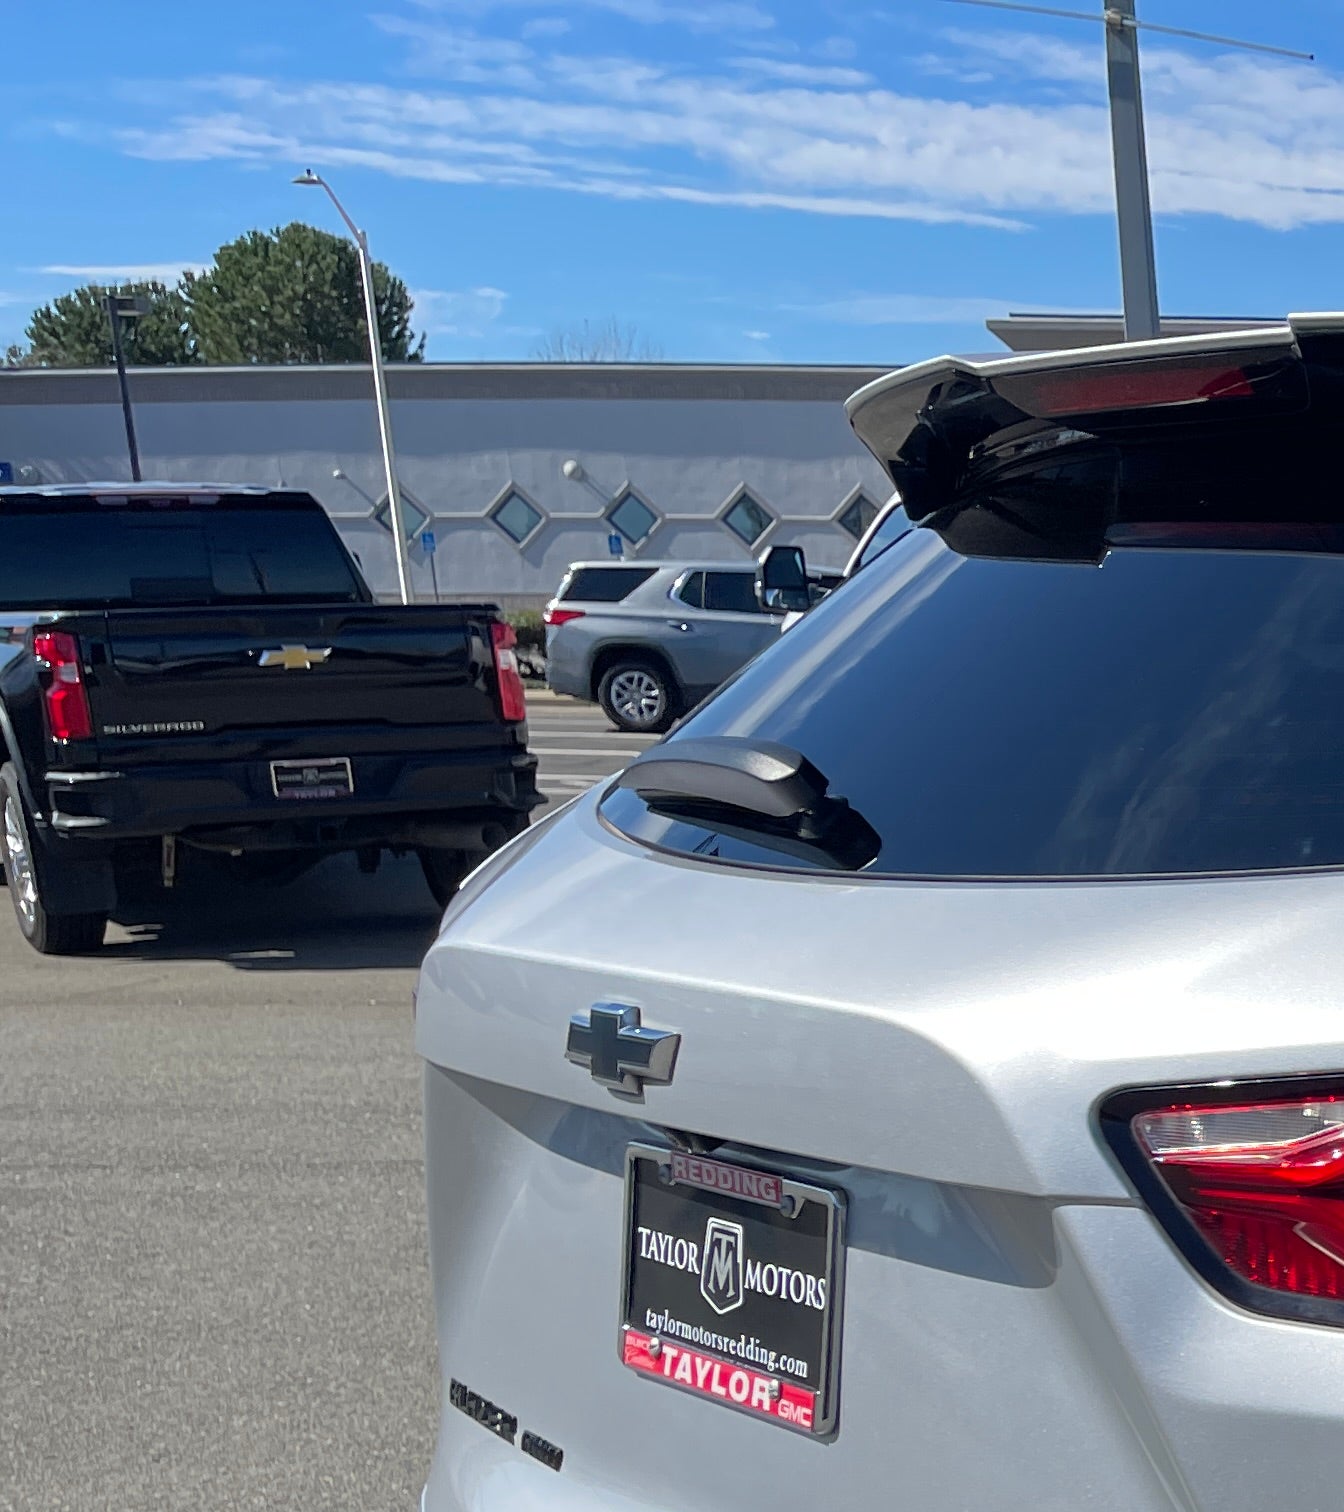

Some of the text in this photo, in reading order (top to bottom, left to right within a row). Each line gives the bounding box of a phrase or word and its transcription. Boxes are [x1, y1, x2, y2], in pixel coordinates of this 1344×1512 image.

[672, 1153, 778, 1202] REDDING
[637, 1226, 700, 1275] TAYLOR
[743, 1258, 826, 1311] MOTORS
[645, 1308, 808, 1379] taylormotorsredding.com
[661, 1344, 772, 1412] TAYLOR
[777, 1399, 813, 1428] GMC
